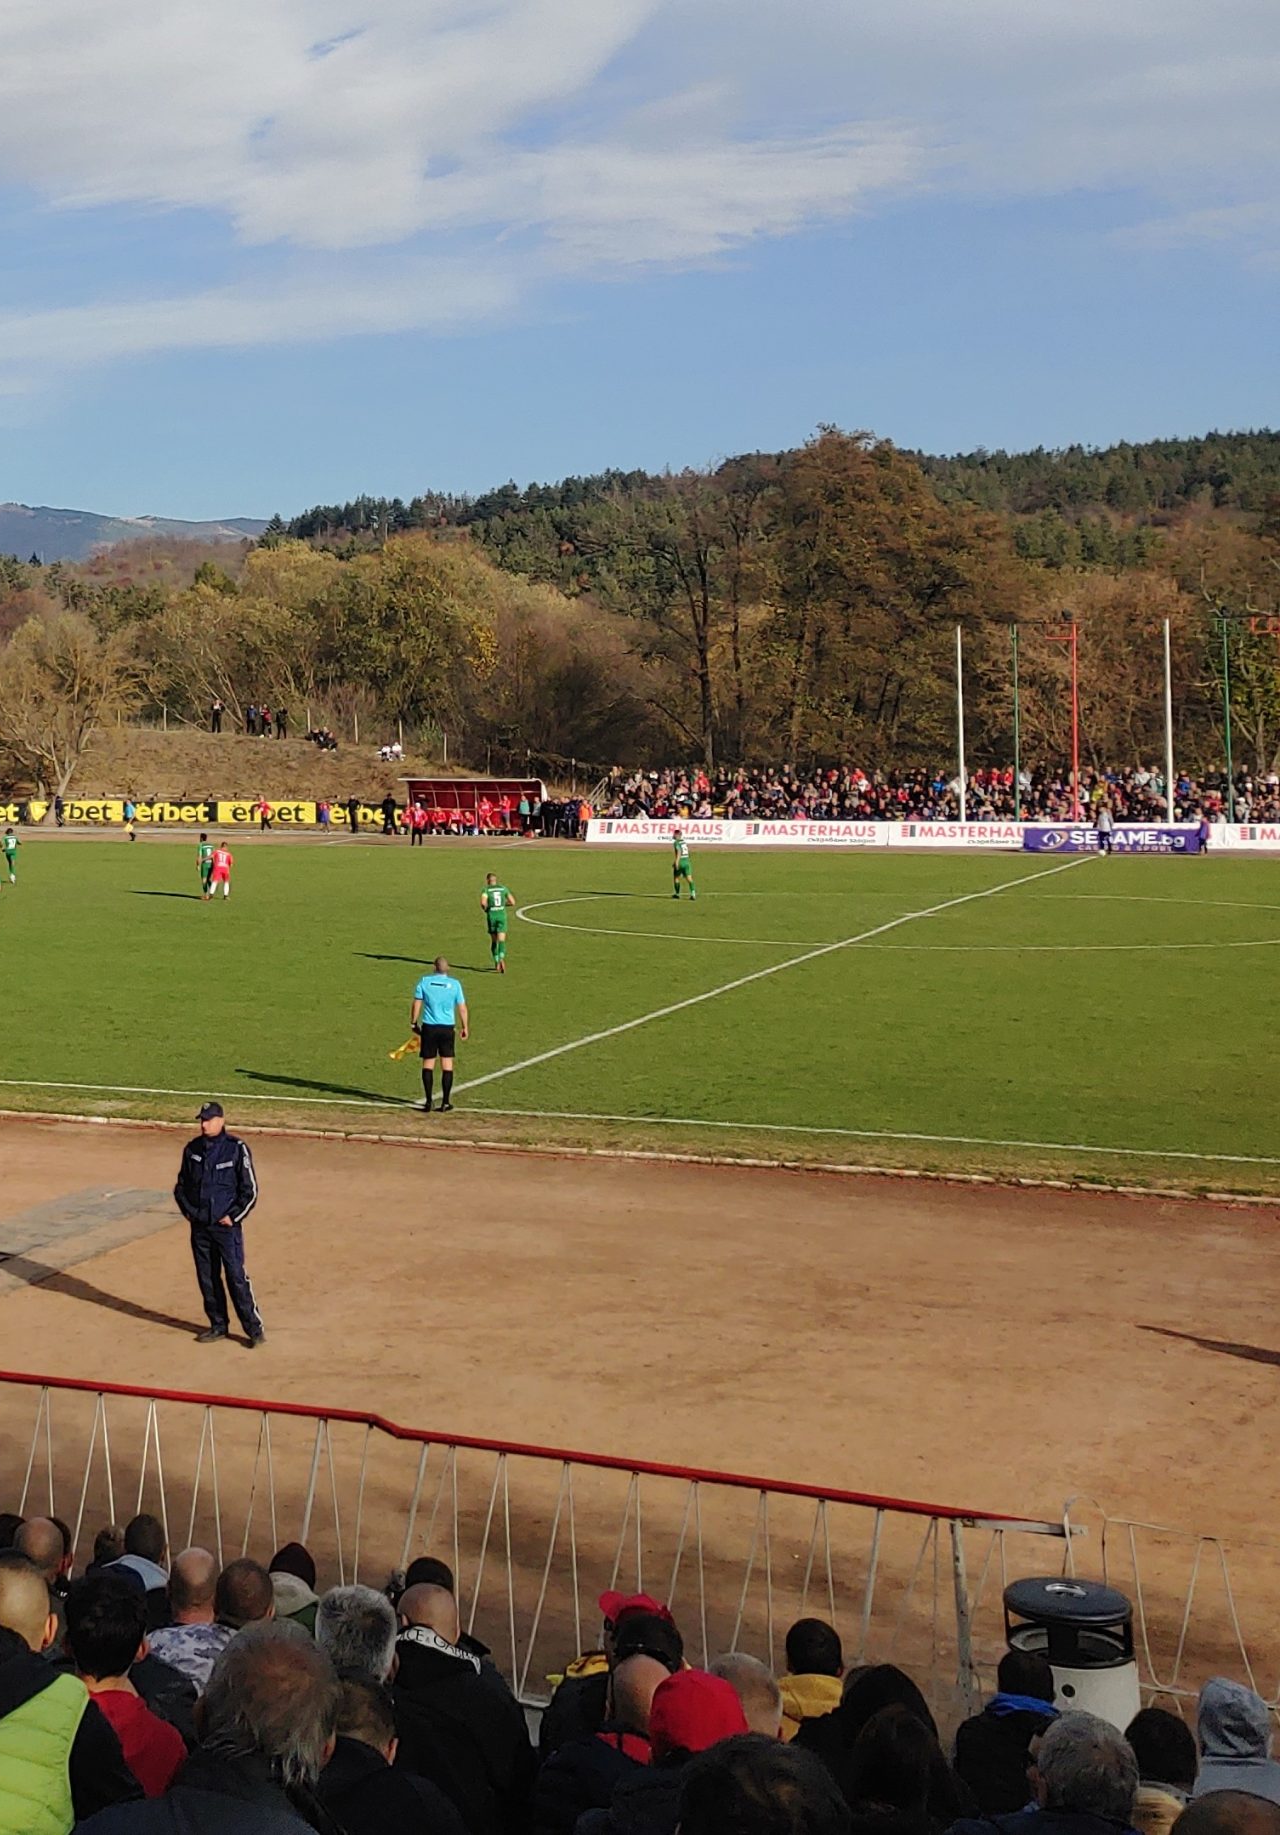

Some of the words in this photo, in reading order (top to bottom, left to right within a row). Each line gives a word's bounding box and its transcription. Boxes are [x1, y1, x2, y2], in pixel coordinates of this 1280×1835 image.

[135, 802, 210, 822] efbet
[615, 823, 723, 835] MASTERHAUS
[762, 824, 876, 837] MASTERHAUS
[1071, 830, 1185, 847] SEAME.bg
